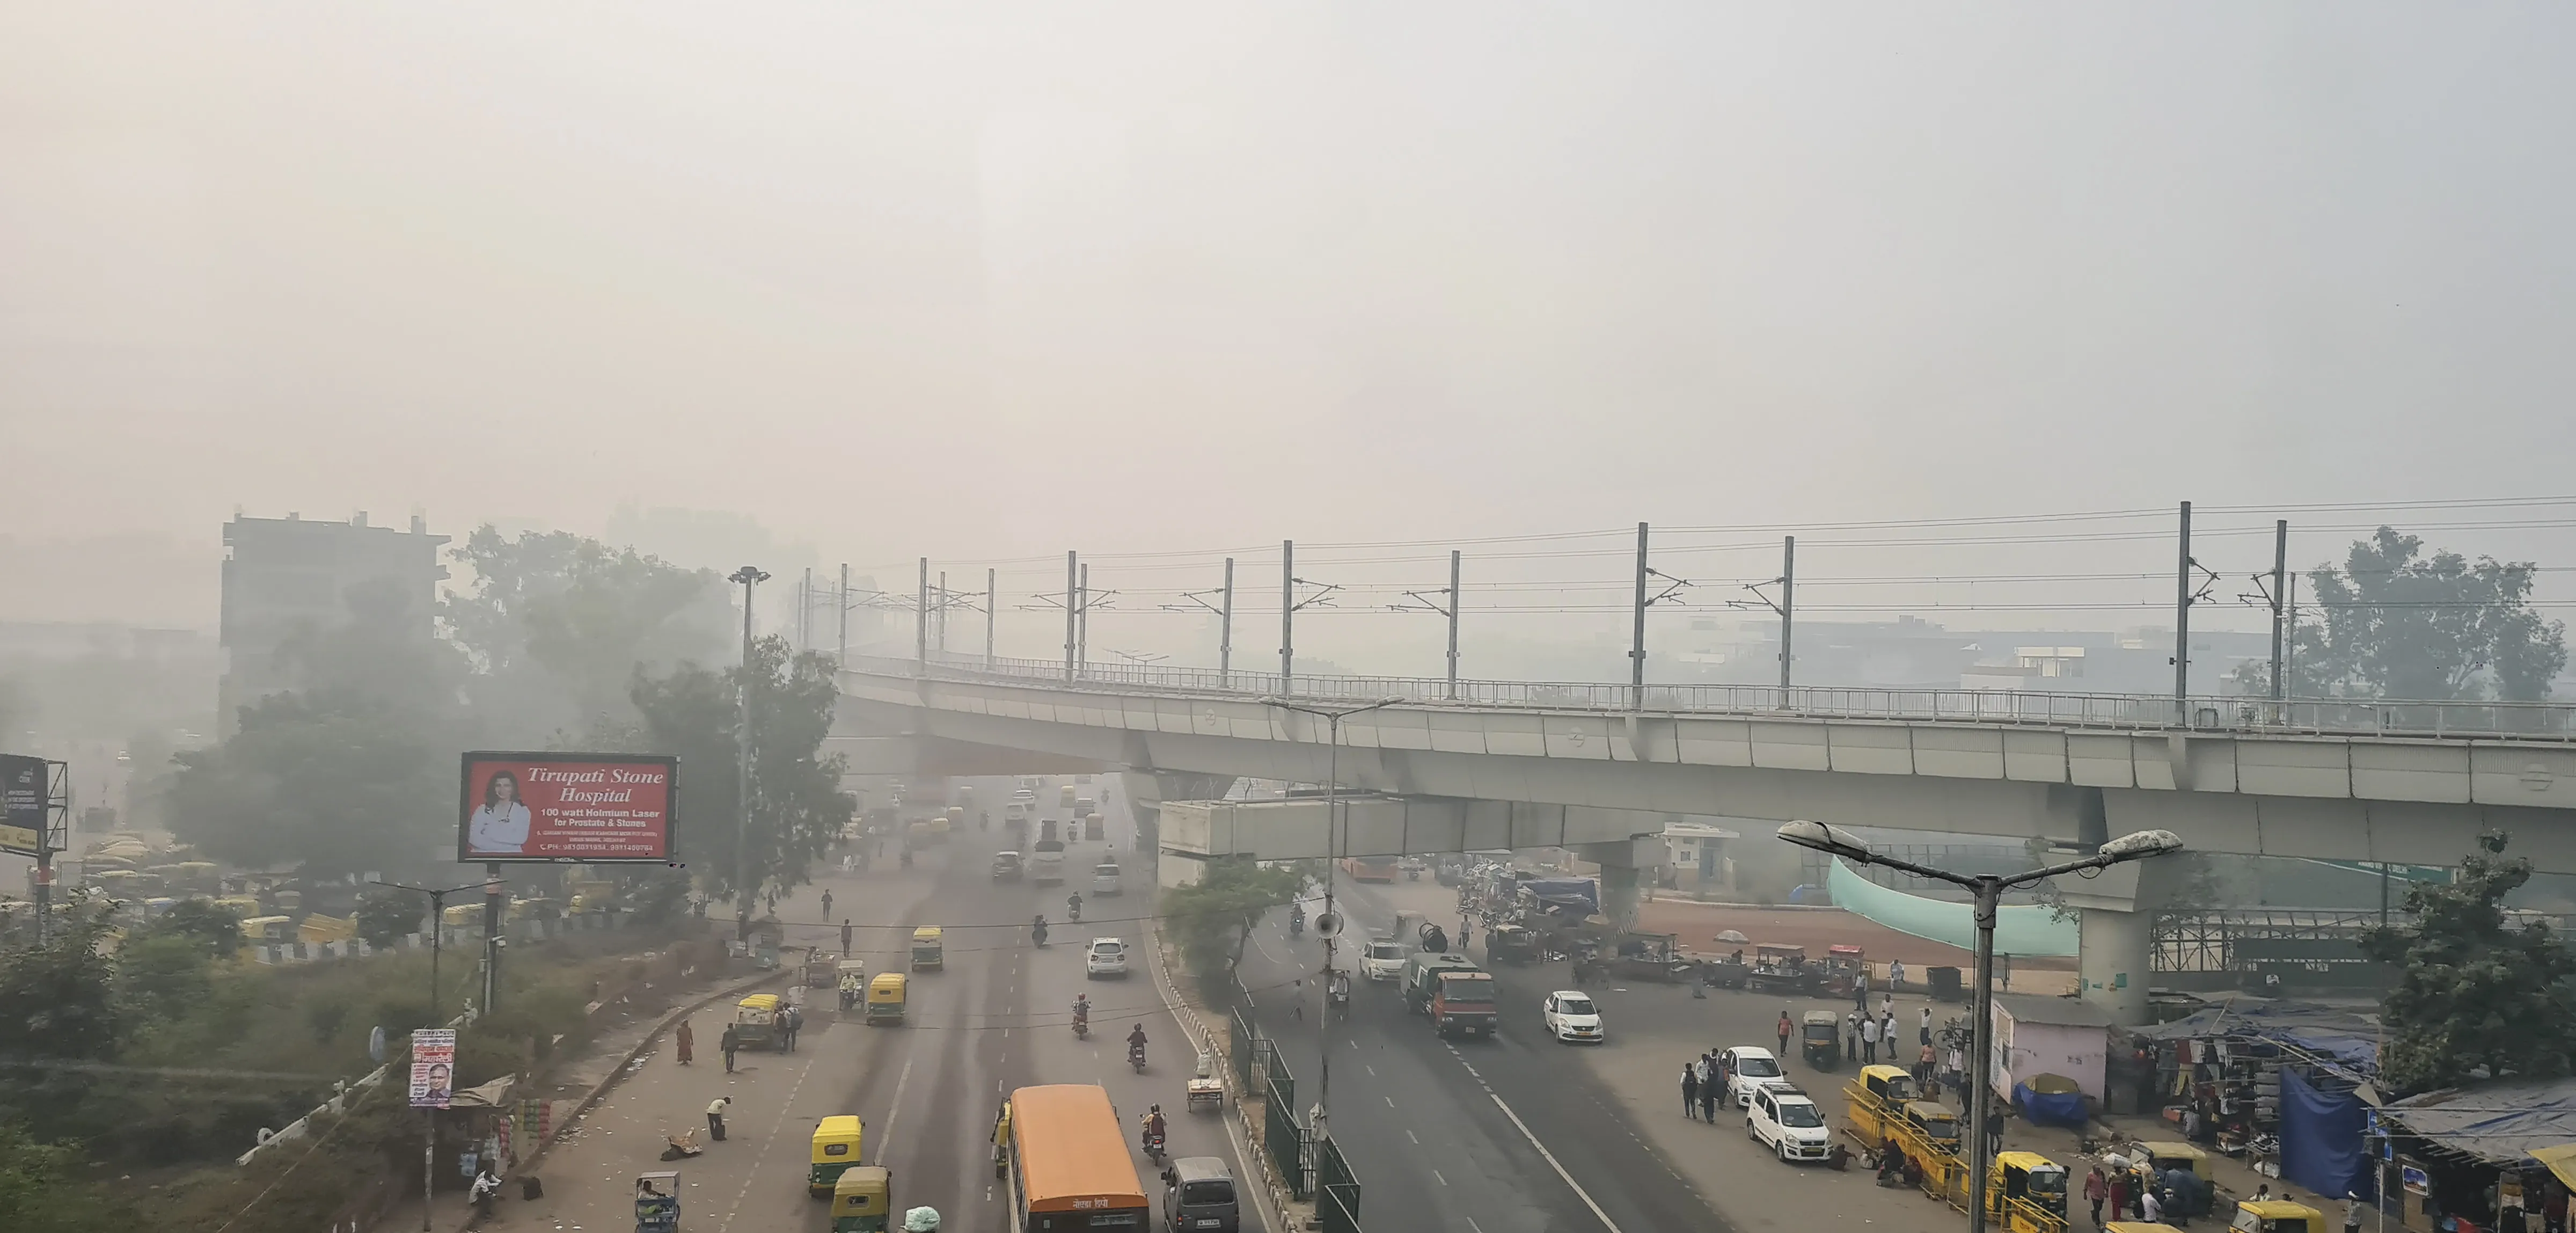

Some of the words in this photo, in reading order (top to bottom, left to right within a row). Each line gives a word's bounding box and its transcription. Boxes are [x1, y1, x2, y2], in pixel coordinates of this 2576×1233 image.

[528, 768, 605, 786] Tirupati
[610, 769, 663, 784] Stone
[559, 787, 632, 805] Hospital
[541, 808, 559, 816] 100
[554, 818, 566, 826] for
[569, 819, 605, 827] Prostate
[608, 819, 614, 827] &
[617, 819, 646, 827] Stones
